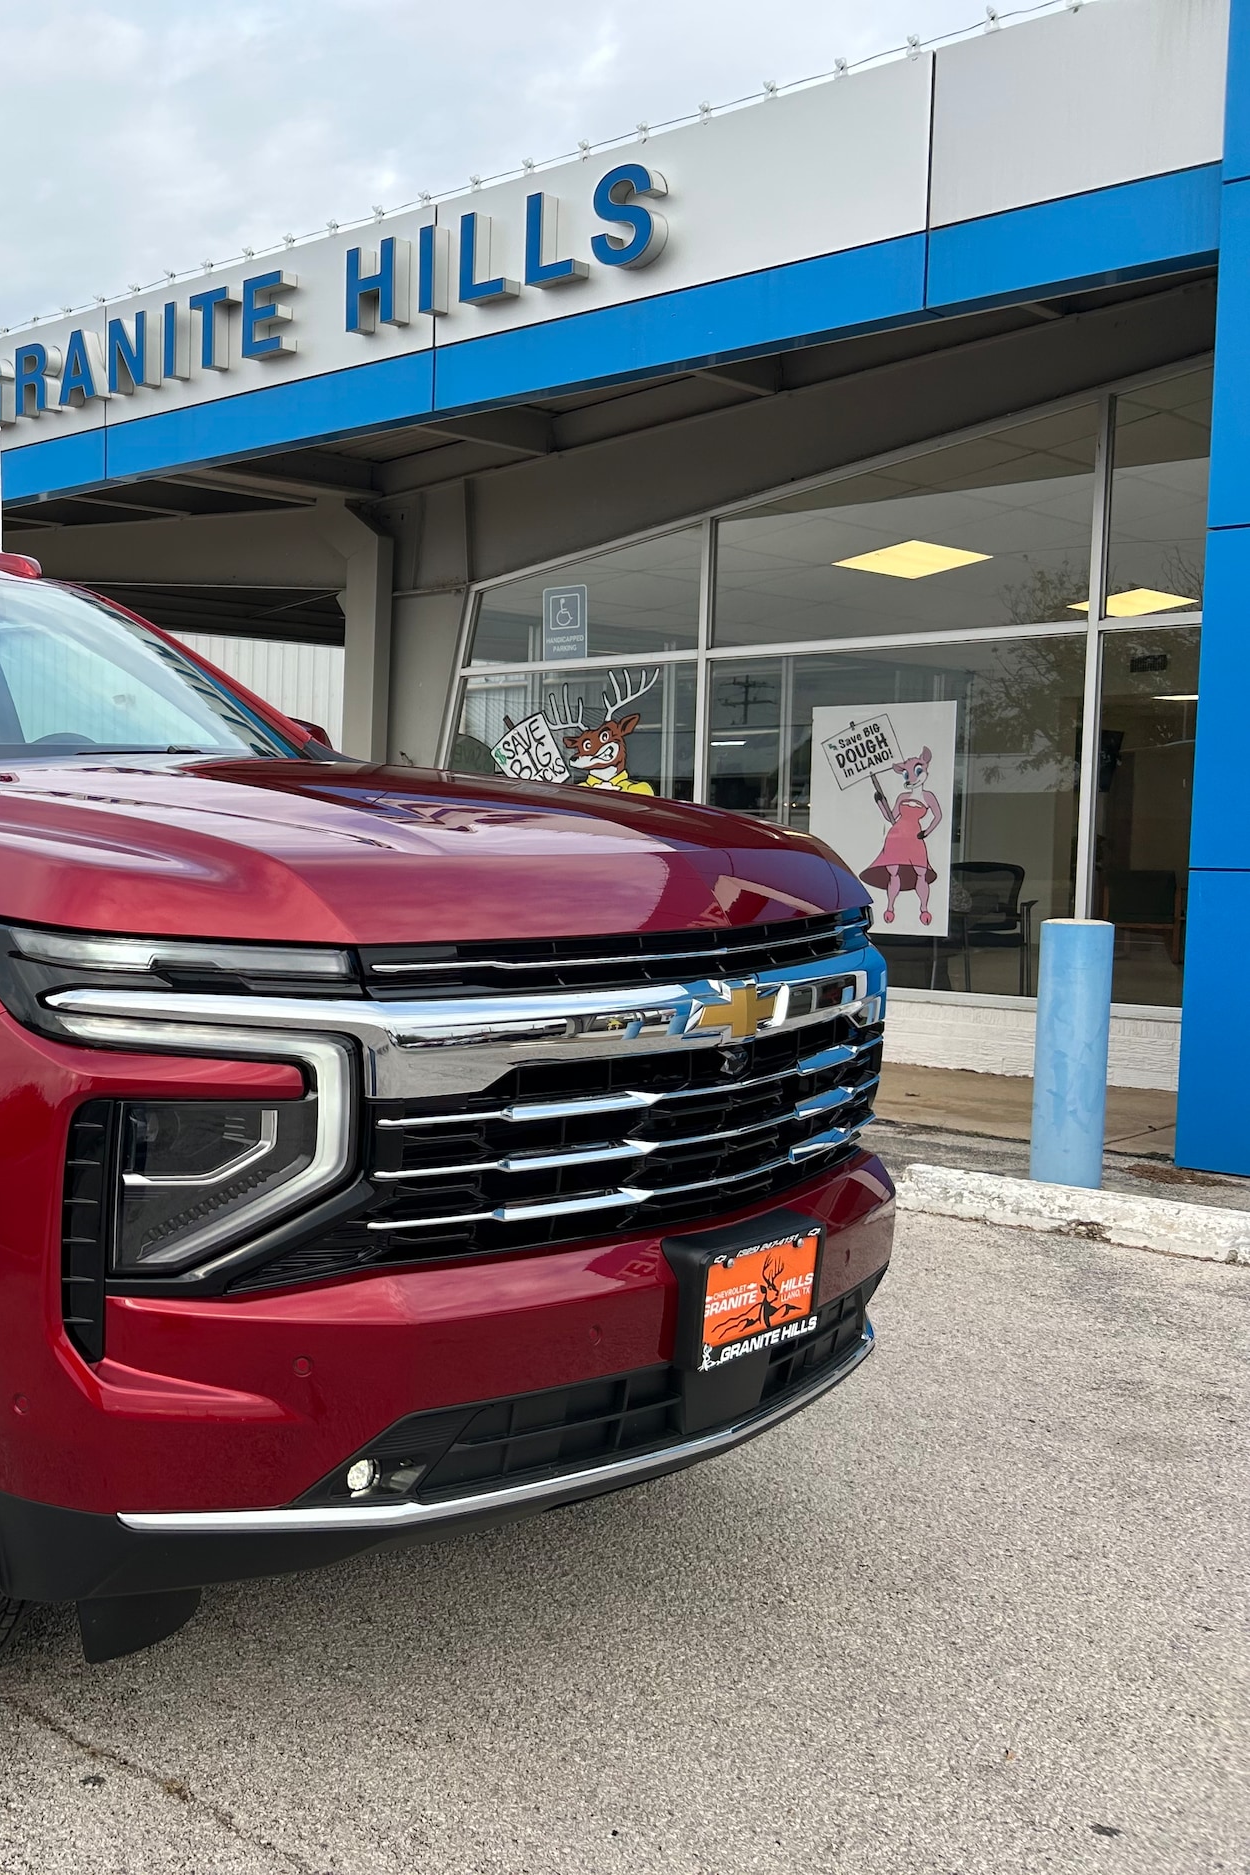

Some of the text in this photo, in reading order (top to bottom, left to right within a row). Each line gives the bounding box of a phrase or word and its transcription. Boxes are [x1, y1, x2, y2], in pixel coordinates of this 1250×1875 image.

[345, 163, 668, 335] HILLS
[546, 635, 584, 644] HANDICAPPED
[553, 644, 577, 653] PARKING
[502, 718, 546, 760] SAVE
[835, 732, 889, 769] DOUGH
[838, 733, 862, 749] Save
[863, 723, 880, 738] BIG
[510, 741, 552, 780] BIG
[854, 748, 894, 773] LLANO!
[704, 1272, 814, 1318] GRANITE HILLS
[713, 1284, 747, 1300] CHEVROLET
[802, 1286, 811, 1296] TX
[720, 1316, 818, 1362] GRANITE HILLS
